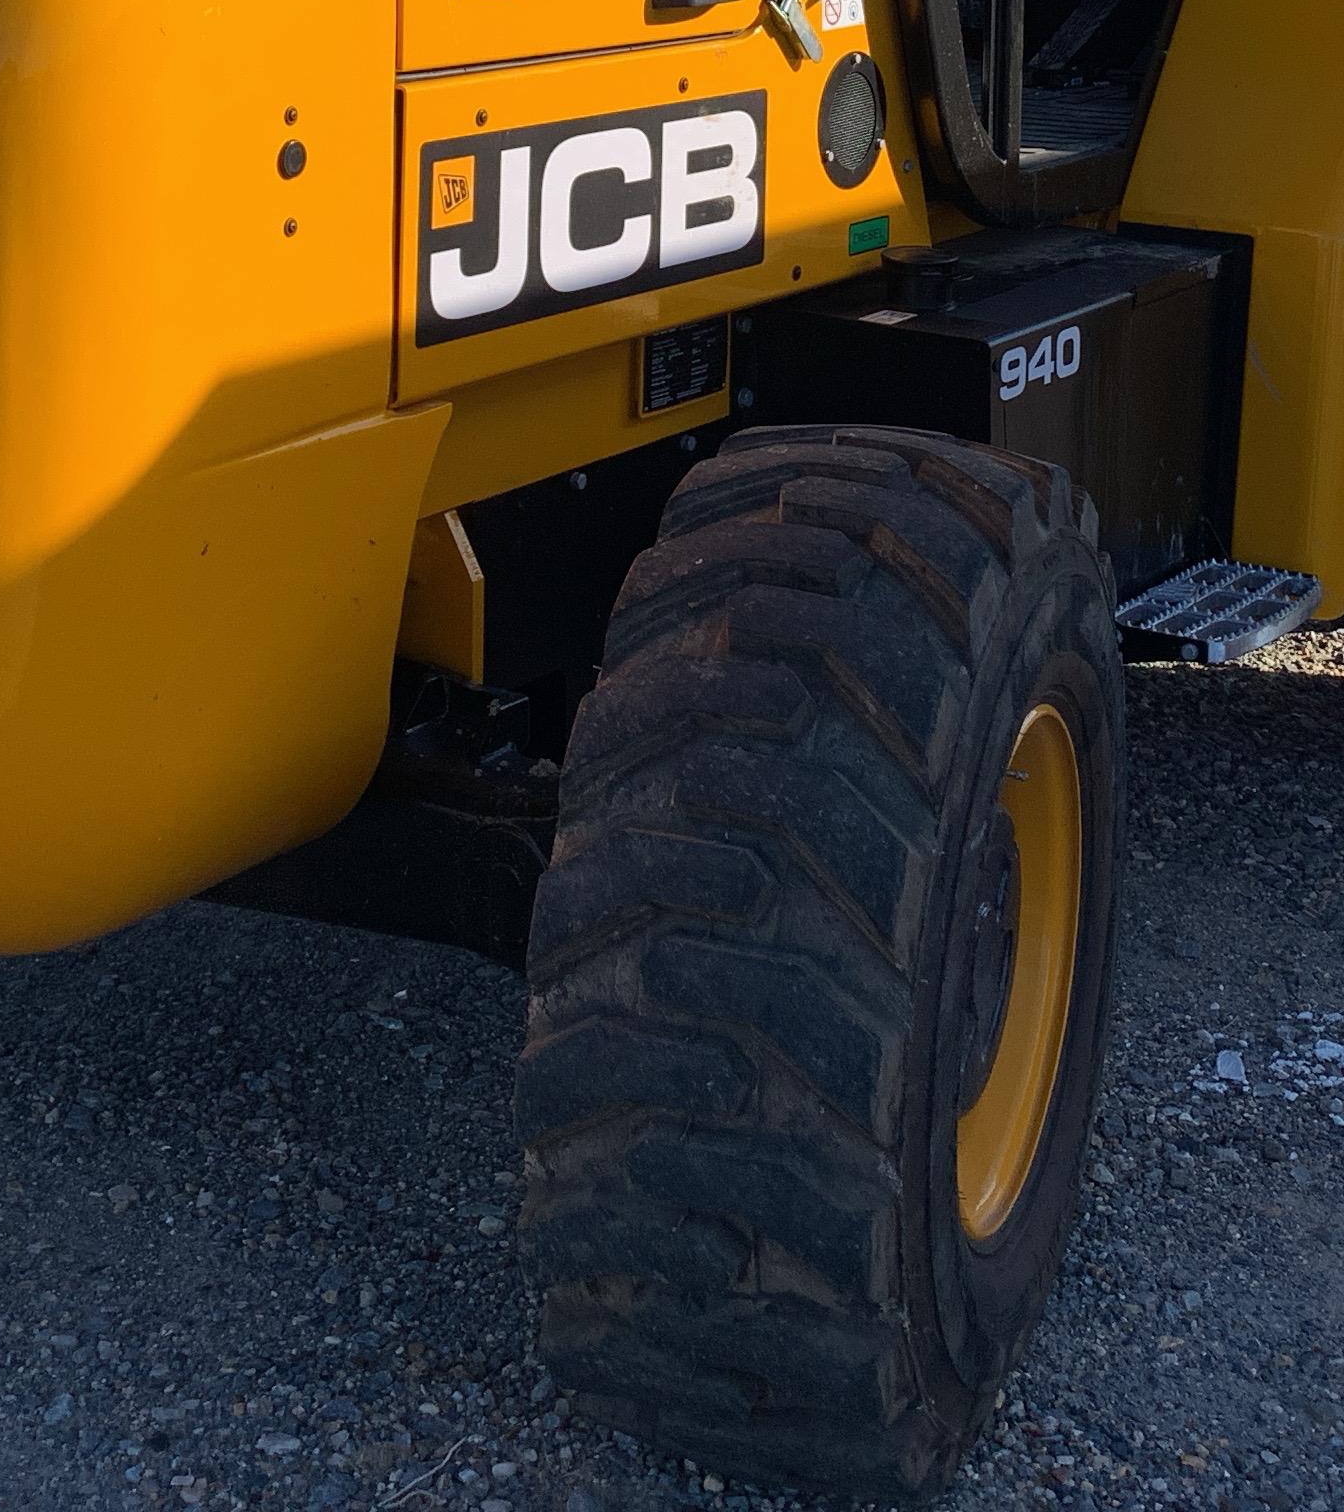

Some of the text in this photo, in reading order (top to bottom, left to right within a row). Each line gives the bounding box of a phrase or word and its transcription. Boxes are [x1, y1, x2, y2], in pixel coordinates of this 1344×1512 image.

[429, 110, 759, 320] JCB
[443, 177, 467, 209] JCB
[999, 325, 1081, 402] 940
